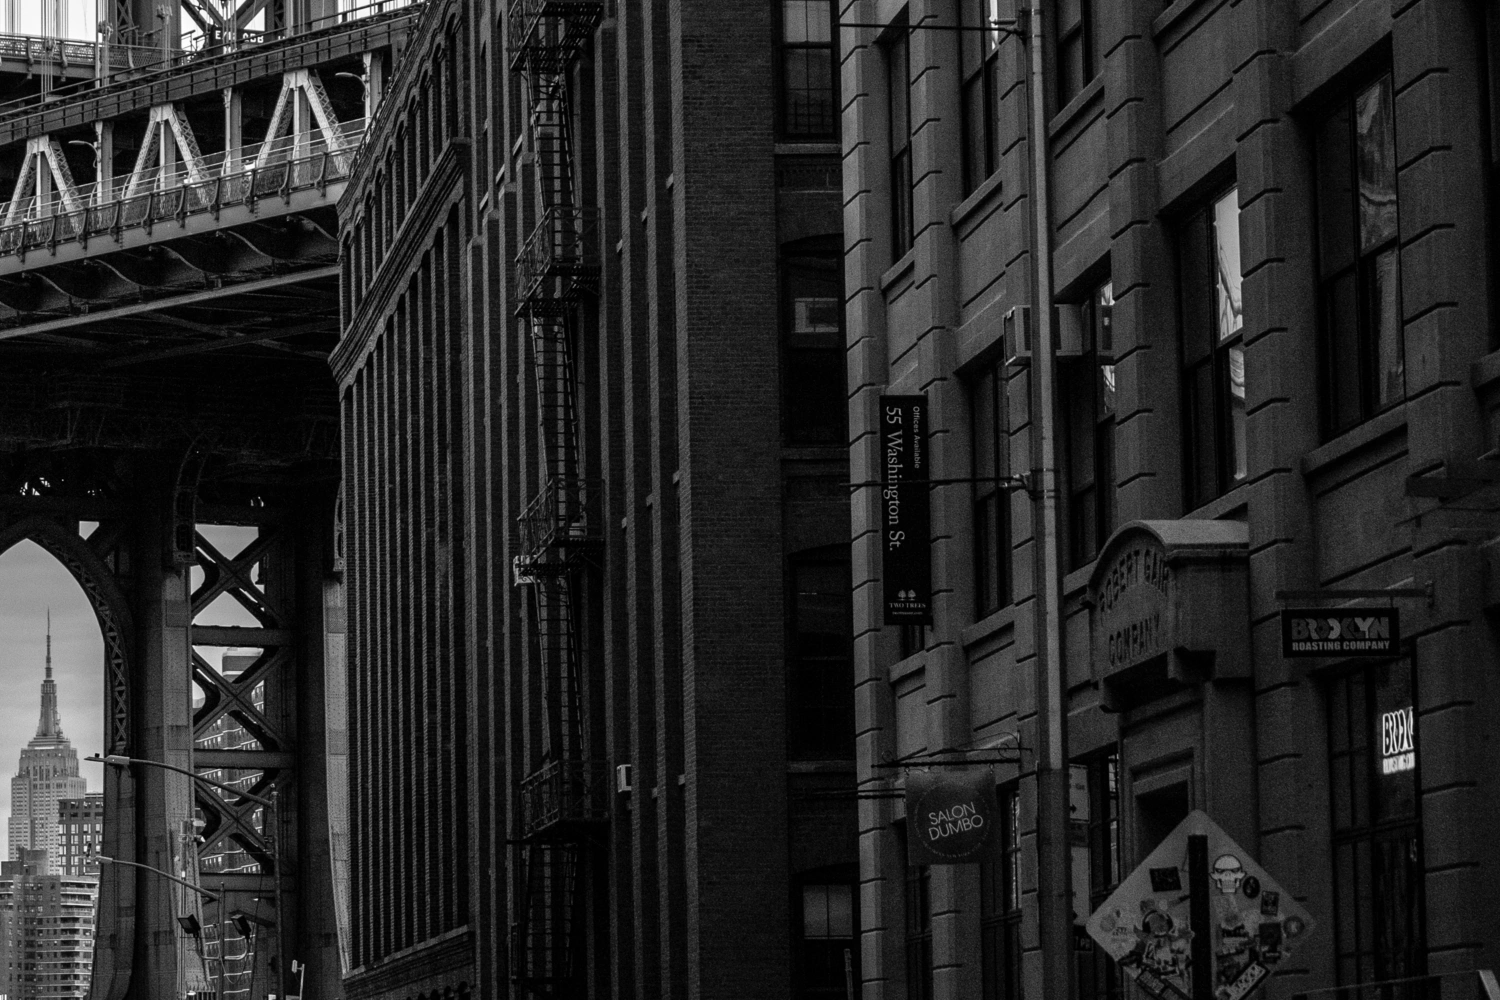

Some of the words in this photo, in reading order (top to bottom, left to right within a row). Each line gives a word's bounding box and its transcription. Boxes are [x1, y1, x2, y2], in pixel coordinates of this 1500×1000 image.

[886, 405, 903, 425] 55
[912, 405, 921, 433] Offices
[913, 434, 922, 469] Available
[883, 429, 904, 526] Washington
[888, 530, 906, 551] St.
[1290, 616, 1390, 641] BROOKLYN
[1291, 640, 1341, 651] ROASTING
[1342, 639, 1391, 651] COMPANY
[928, 801, 976, 825] SALON
[928, 814, 984, 841] DUMBO
